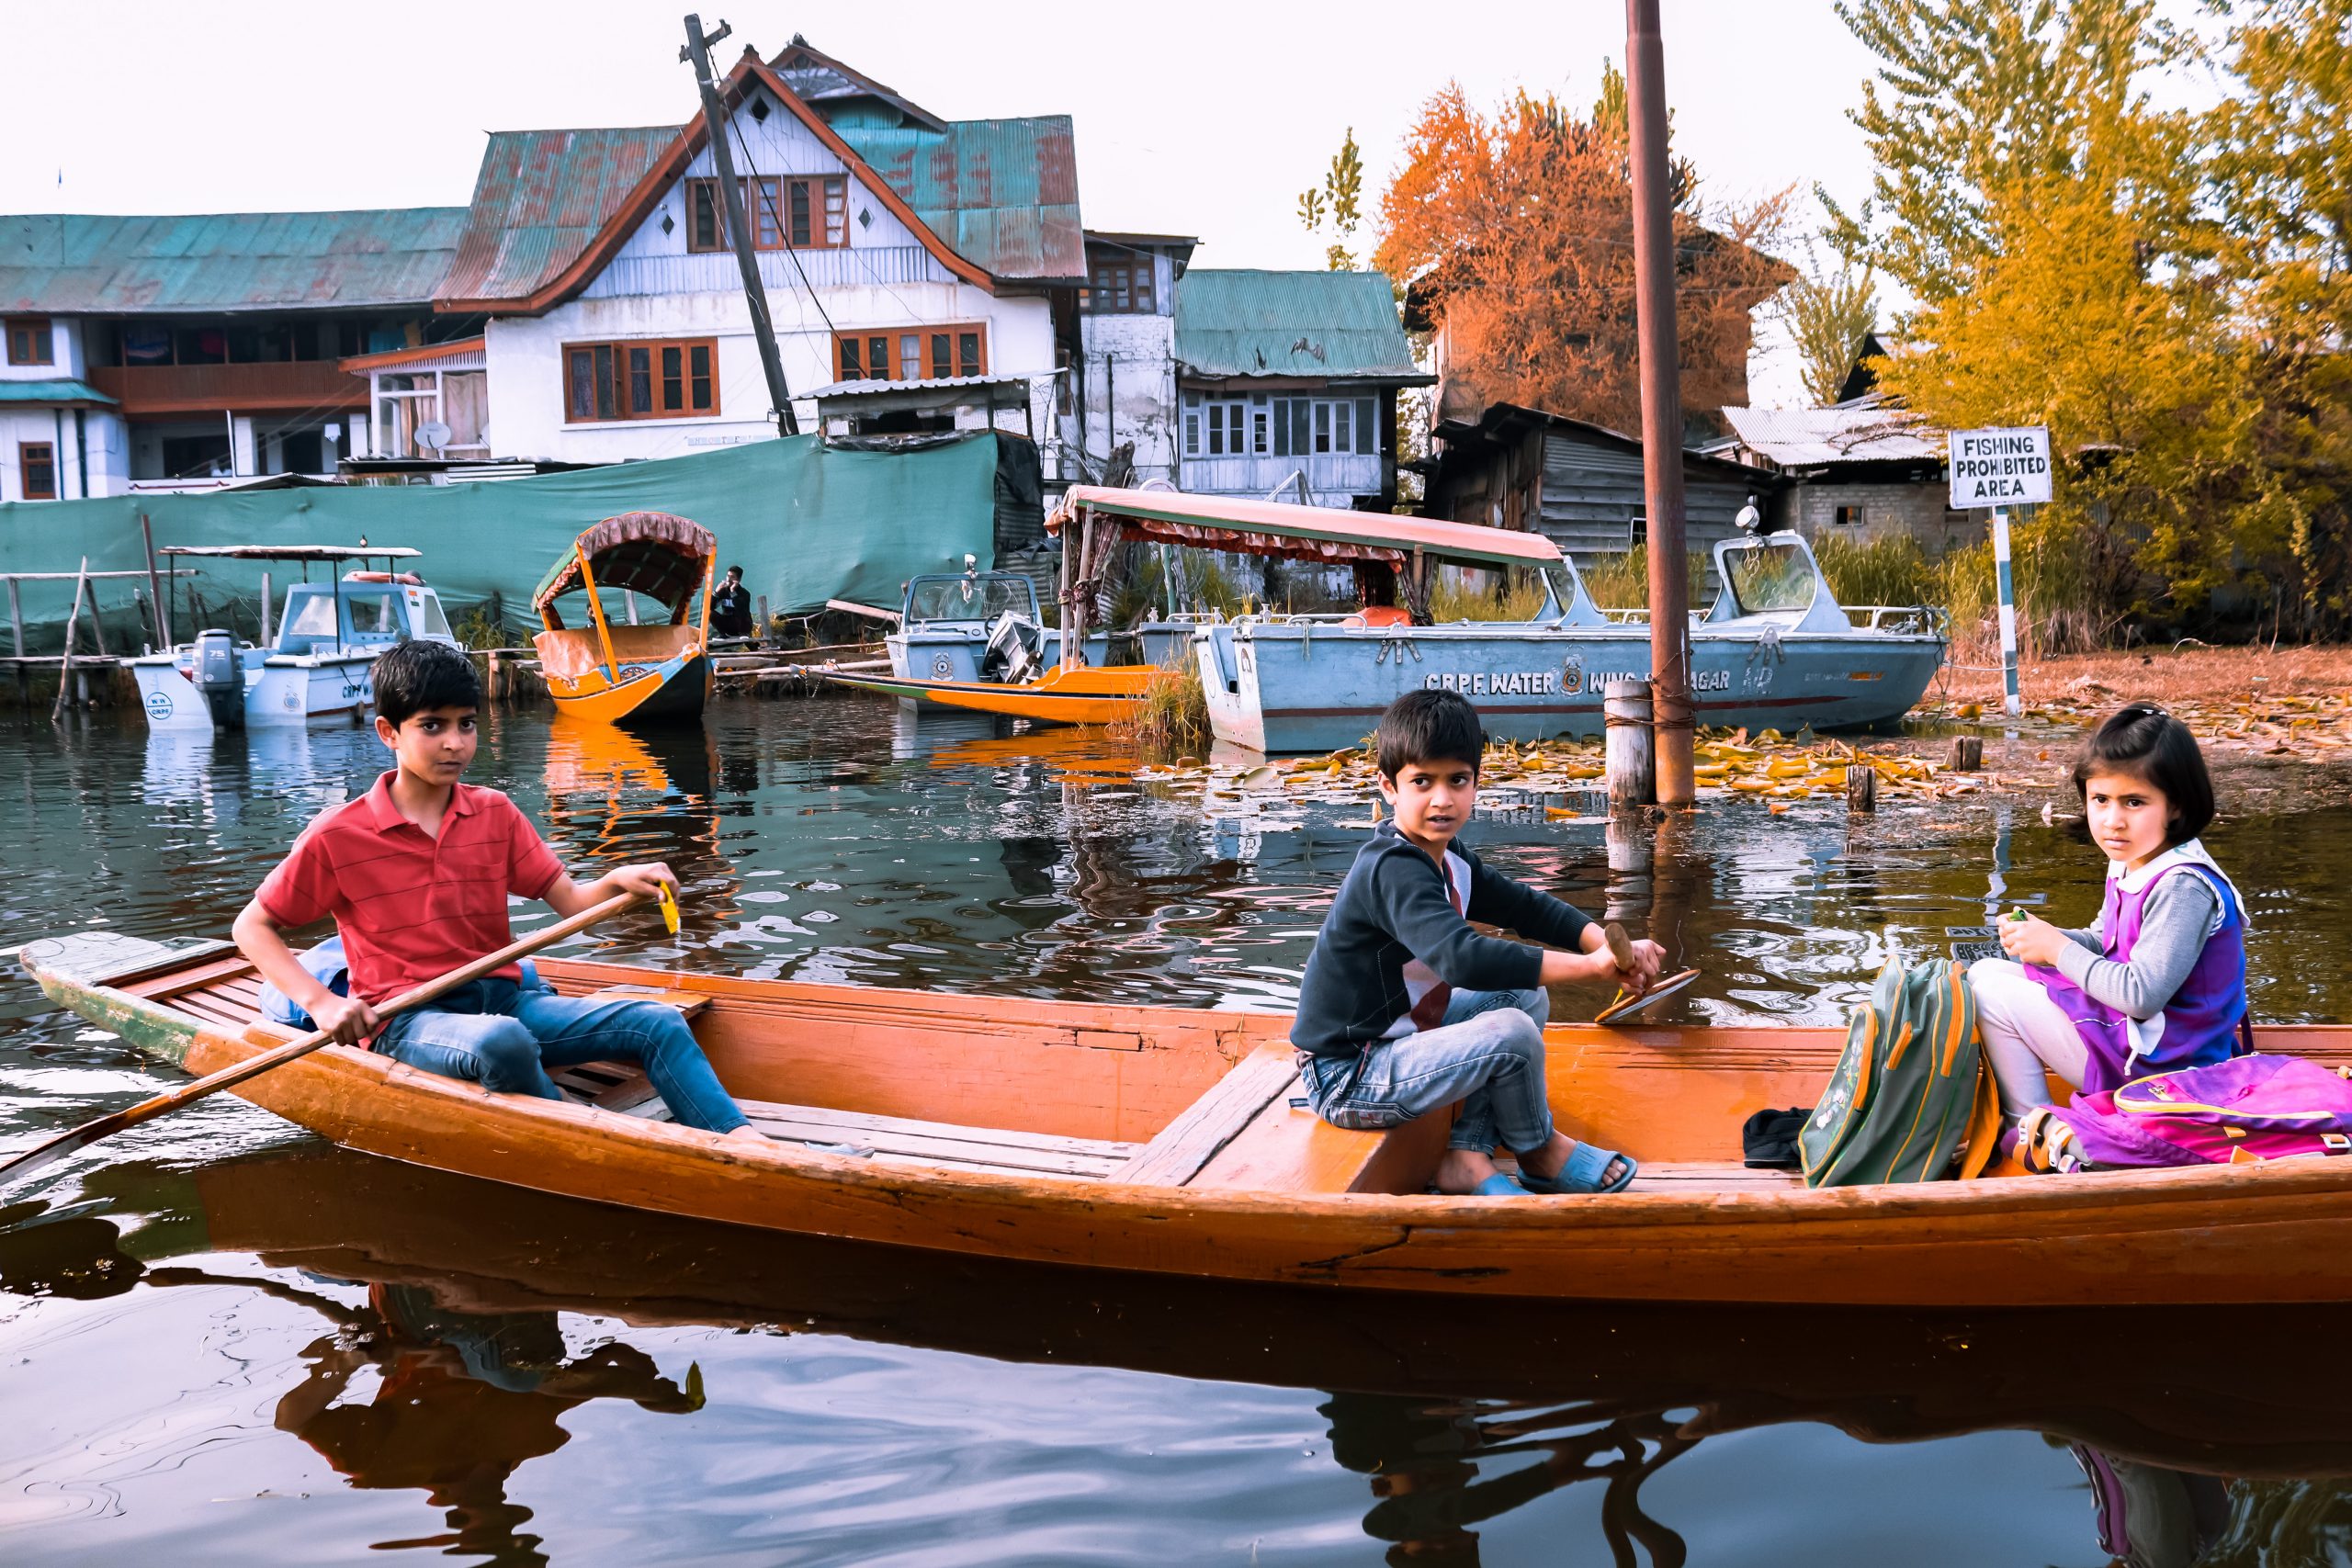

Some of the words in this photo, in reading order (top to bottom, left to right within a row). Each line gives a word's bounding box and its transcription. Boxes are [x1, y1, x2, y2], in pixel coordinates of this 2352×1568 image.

[1963, 437, 2034, 456] FISHING
[1956, 457, 2046, 478] PROHIBITED
[1974, 479, 2025, 498] AREA
[209, 649, 226, 658] 75
[1489, 672, 1555, 694] WATER
